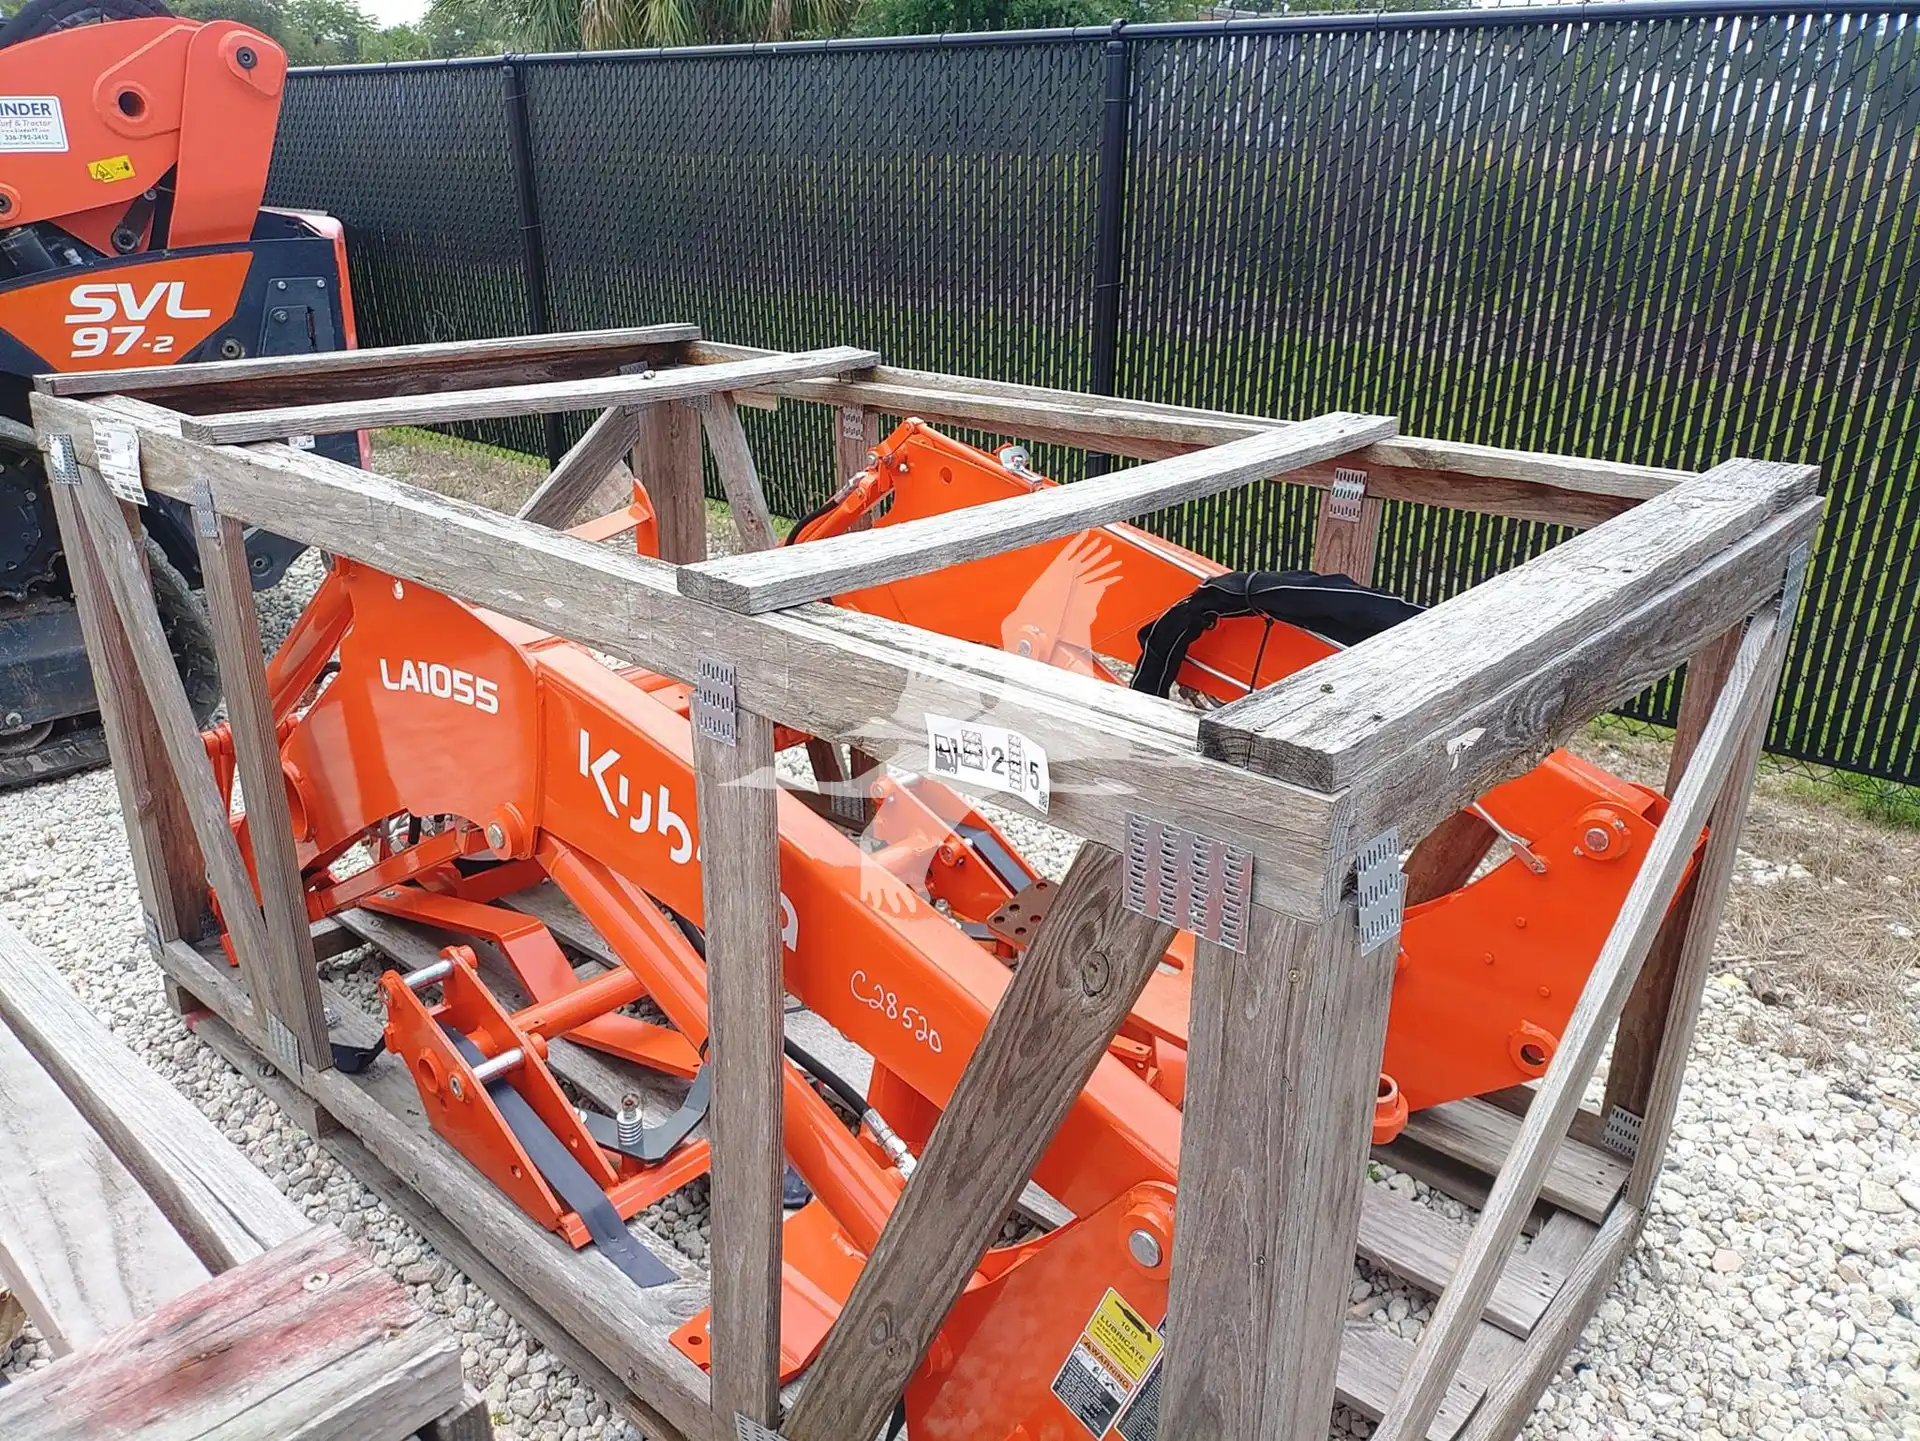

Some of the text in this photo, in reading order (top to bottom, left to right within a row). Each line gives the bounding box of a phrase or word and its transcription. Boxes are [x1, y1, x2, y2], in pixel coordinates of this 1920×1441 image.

[64, 281, 212, 324] SVL
[379, 658, 499, 715] LA1055
[850, 969, 943, 1053] C28520
[1099, 1314, 1146, 1363] LUBRICATE
[1090, 1347, 1129, 1388] WARNING
